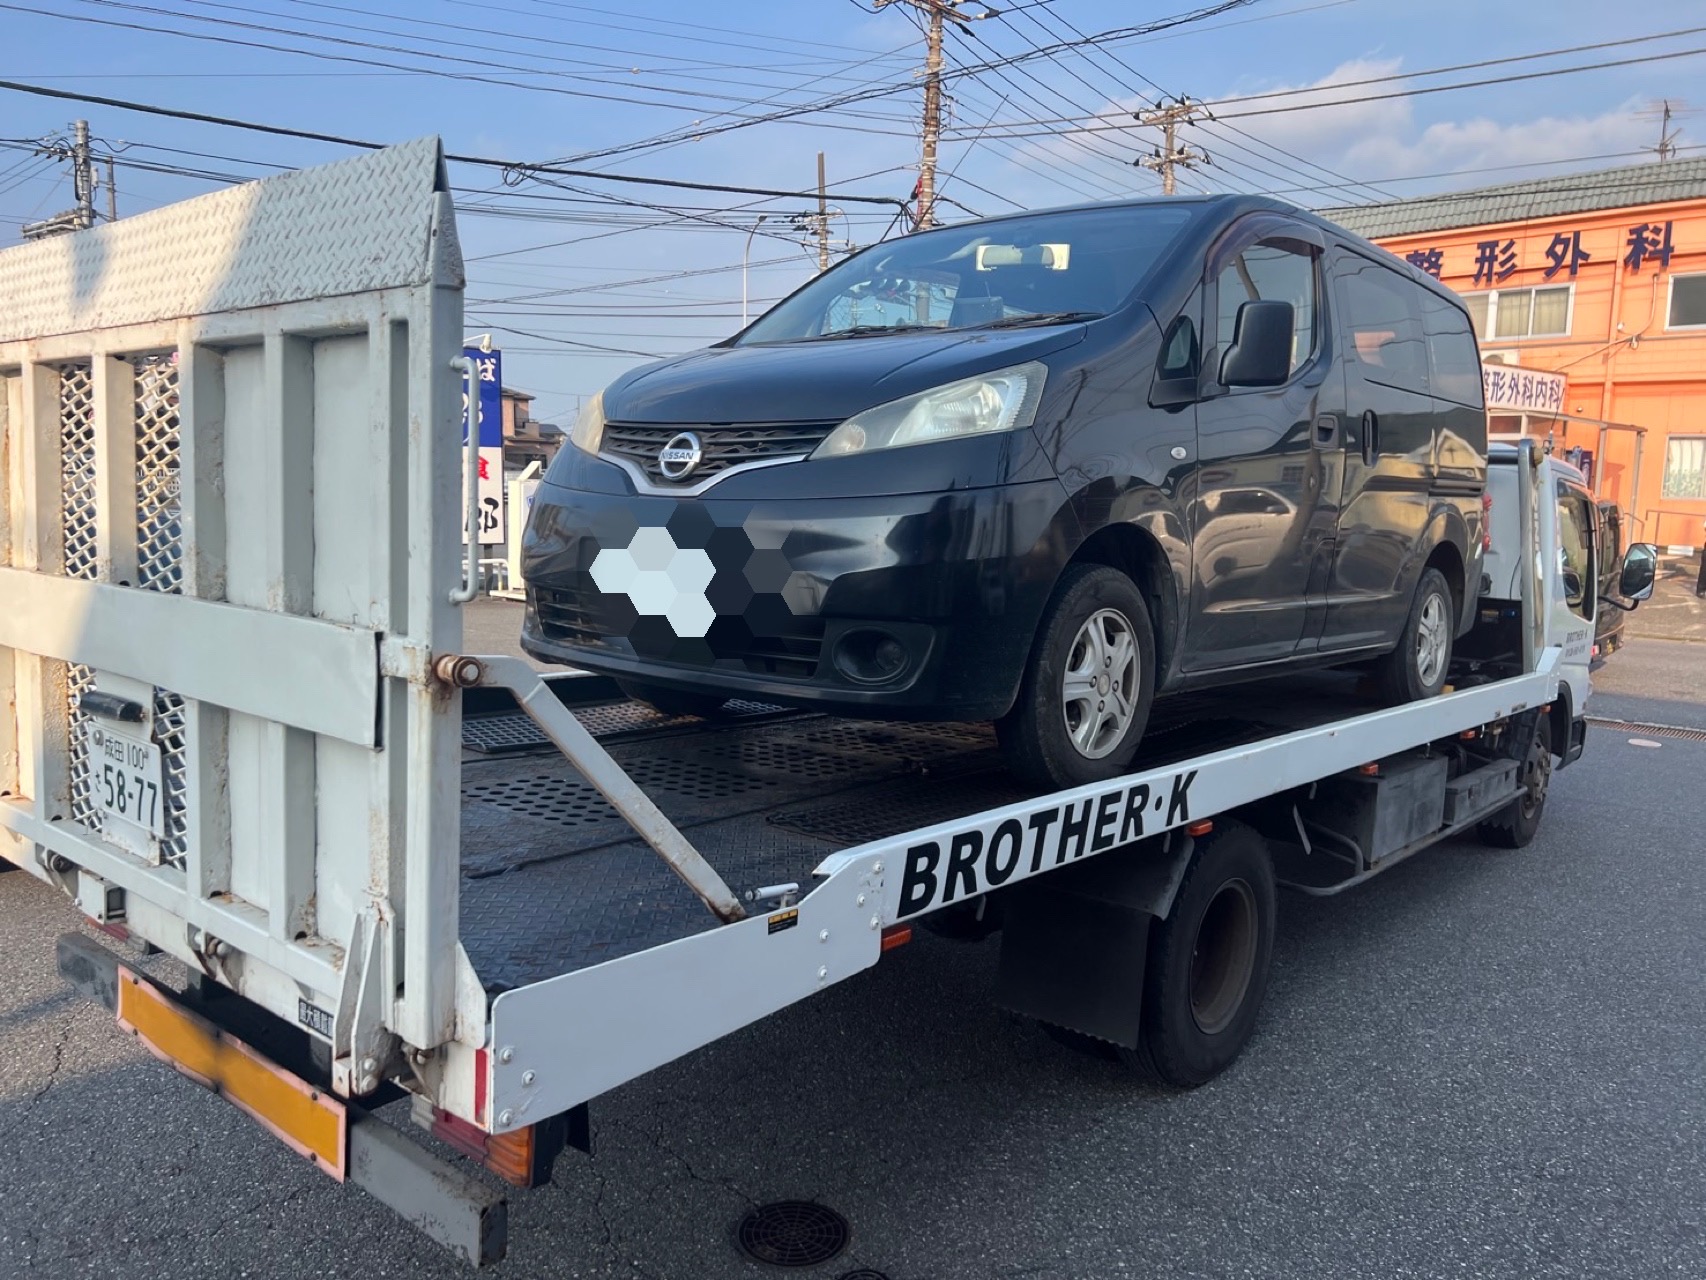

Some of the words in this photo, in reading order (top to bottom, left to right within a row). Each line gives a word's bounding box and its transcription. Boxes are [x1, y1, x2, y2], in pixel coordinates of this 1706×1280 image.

[661, 452, 694, 460] NISSAN
[105, 737, 124, 762] 成田
[127, 743, 146, 770] 100
[104, 763, 157, 827] 58-77
